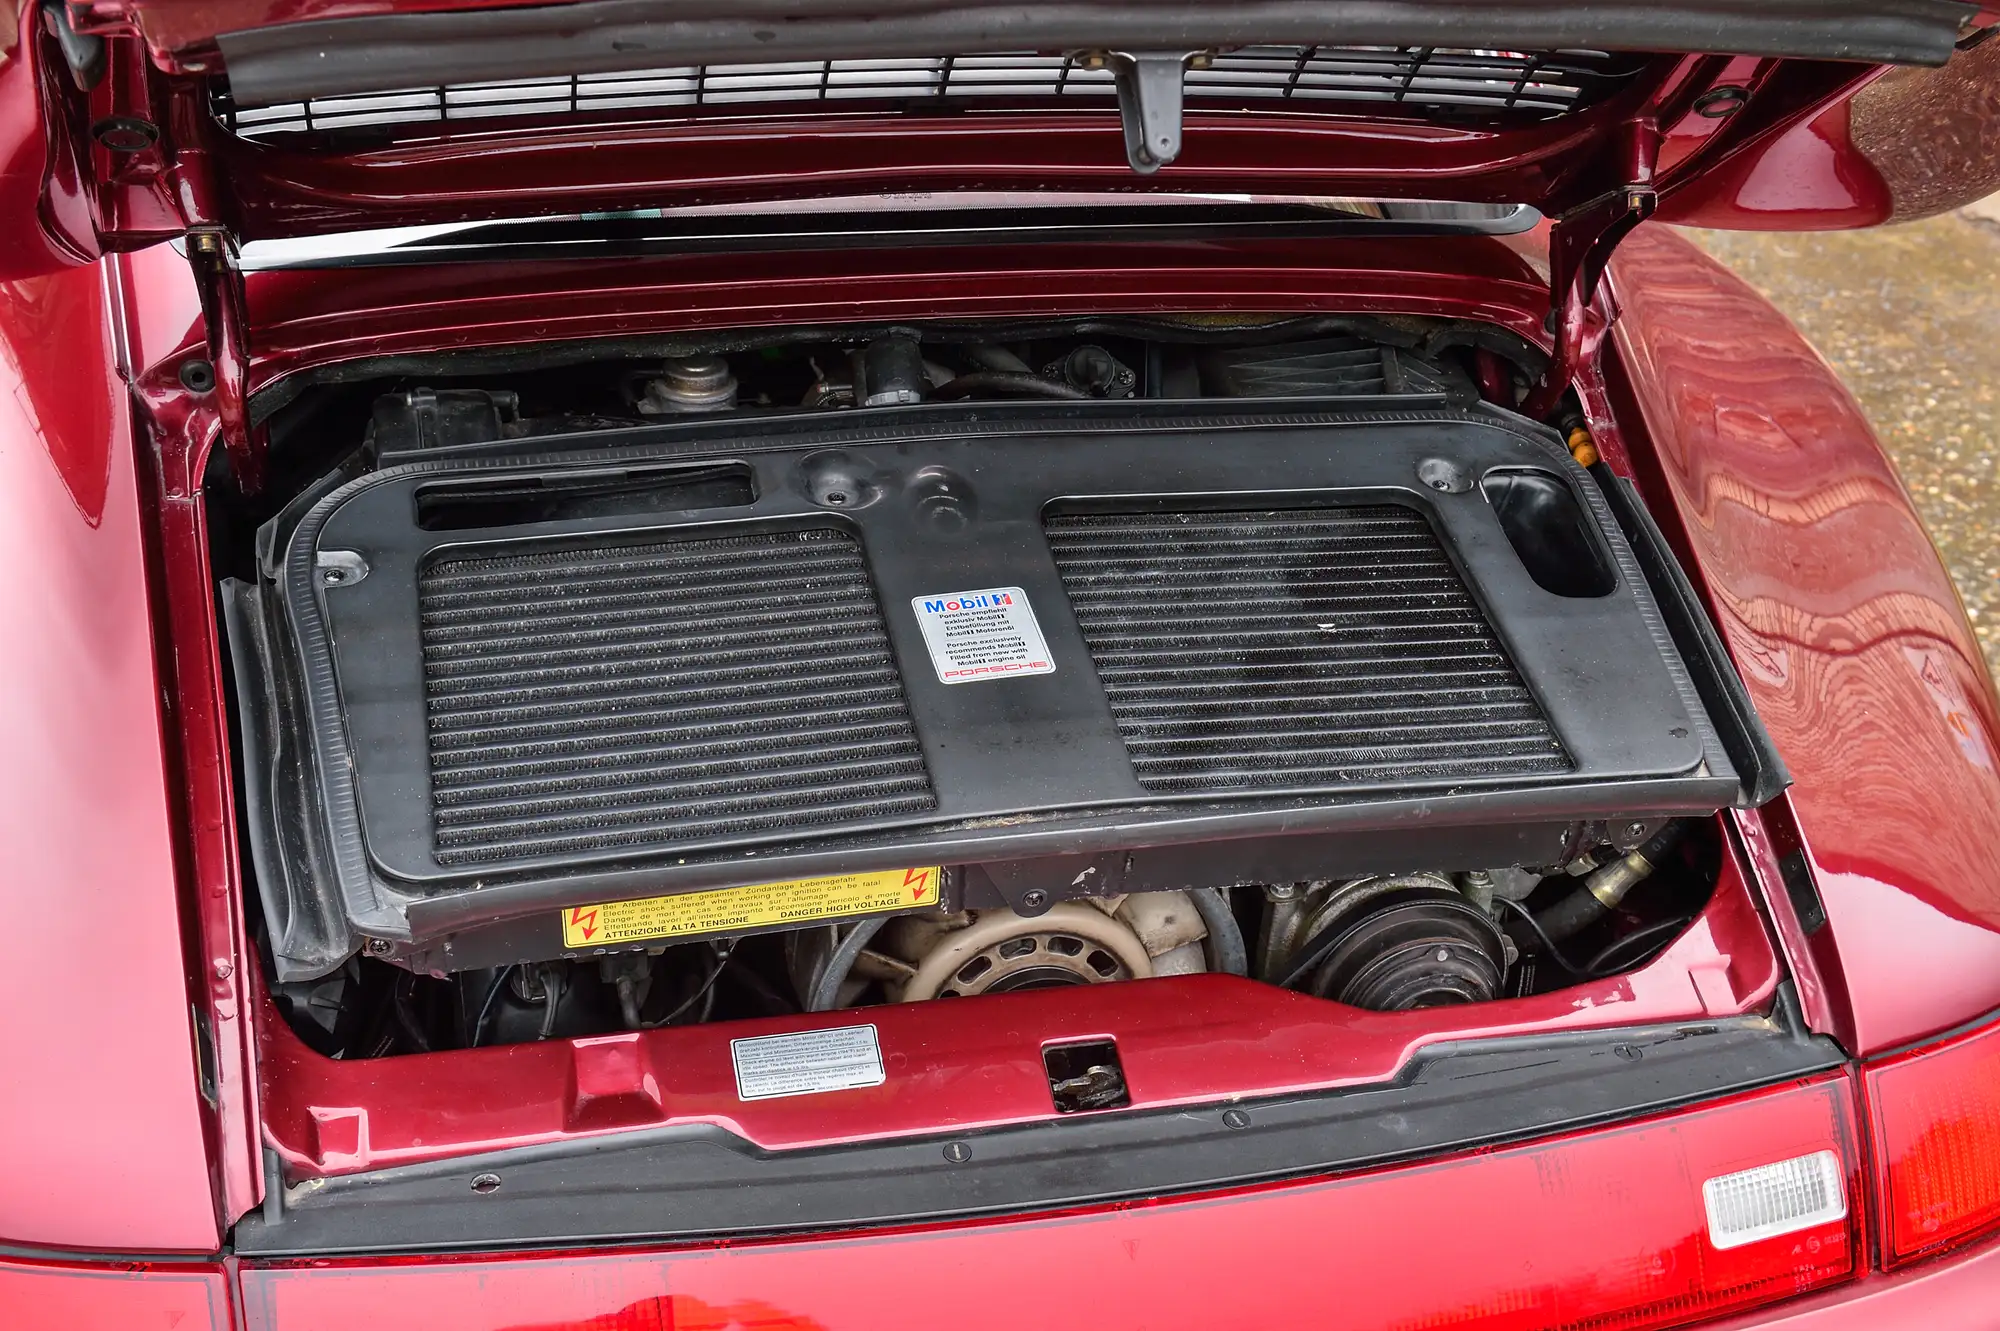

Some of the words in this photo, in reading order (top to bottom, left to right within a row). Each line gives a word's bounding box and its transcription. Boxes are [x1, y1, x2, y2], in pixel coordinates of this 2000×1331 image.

[925, 596, 988, 614] Mobil
[939, 611, 970, 619] Porsche
[972, 608, 1007, 616] empfiehlt
[944, 617, 974, 625] exklusiv
[946, 622, 996, 631] Erstbefüllung
[976, 626, 1014, 634] Motorenöl
[946, 645, 996, 654] recommends
[947, 640, 978, 648] Porsche
[980, 636, 1022, 644] exclusively
[945, 661, 1048, 678] PORSCHE
[622, 900, 657, 908] Arbeiten
[699, 891, 740, 900] gesamten
[746, 884, 794, 894] Zündanlage
[800, 877, 856, 888] Lebensgefahr
[641, 905, 665, 913] shock
[671, 901, 705, 909] suffered
[739, 893, 771, 901] working
[792, 888, 822, 896] ignition
[604, 916, 634, 924] Danger
[788, 893, 829, 902] l'allumage
[604, 921, 653, 931] Effettuando
[687, 913, 722, 921] all'intero
[728, 908, 763, 916] impianto
[769, 901, 822, 911] d'accensione
[828, 897, 859, 905] pericolo
[780, 908, 822, 918] DANGER
[826, 904, 850, 912] HIGH
[854, 898, 900, 909] VOLTAGE
[605, 926, 667, 939] ATTENZIONE
[671, 923, 696, 931] ALTA
[700, 916, 749, 927] TENSIONE
